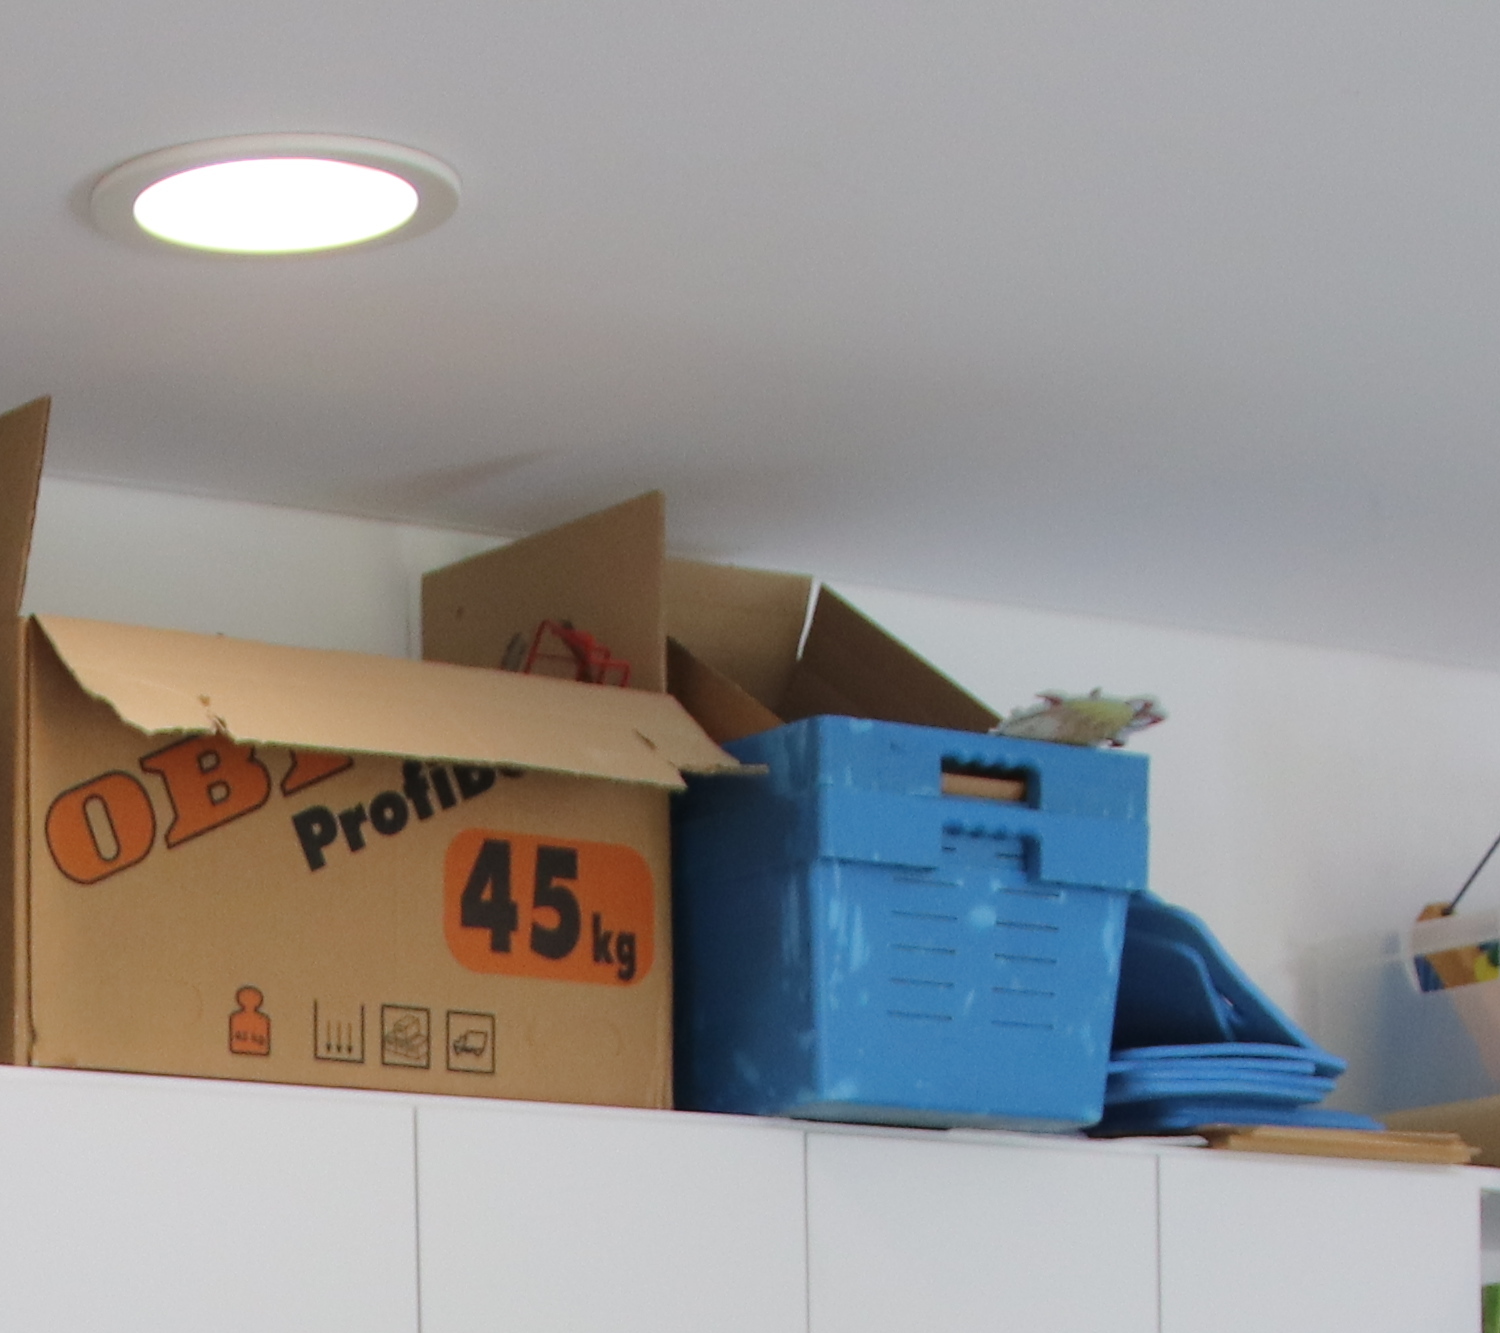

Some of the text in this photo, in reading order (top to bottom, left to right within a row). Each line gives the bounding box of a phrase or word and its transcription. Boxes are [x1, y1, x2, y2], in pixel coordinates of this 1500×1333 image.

[291, 760, 525, 872] ProfiB
[459, 840, 637, 981] 45 kg
